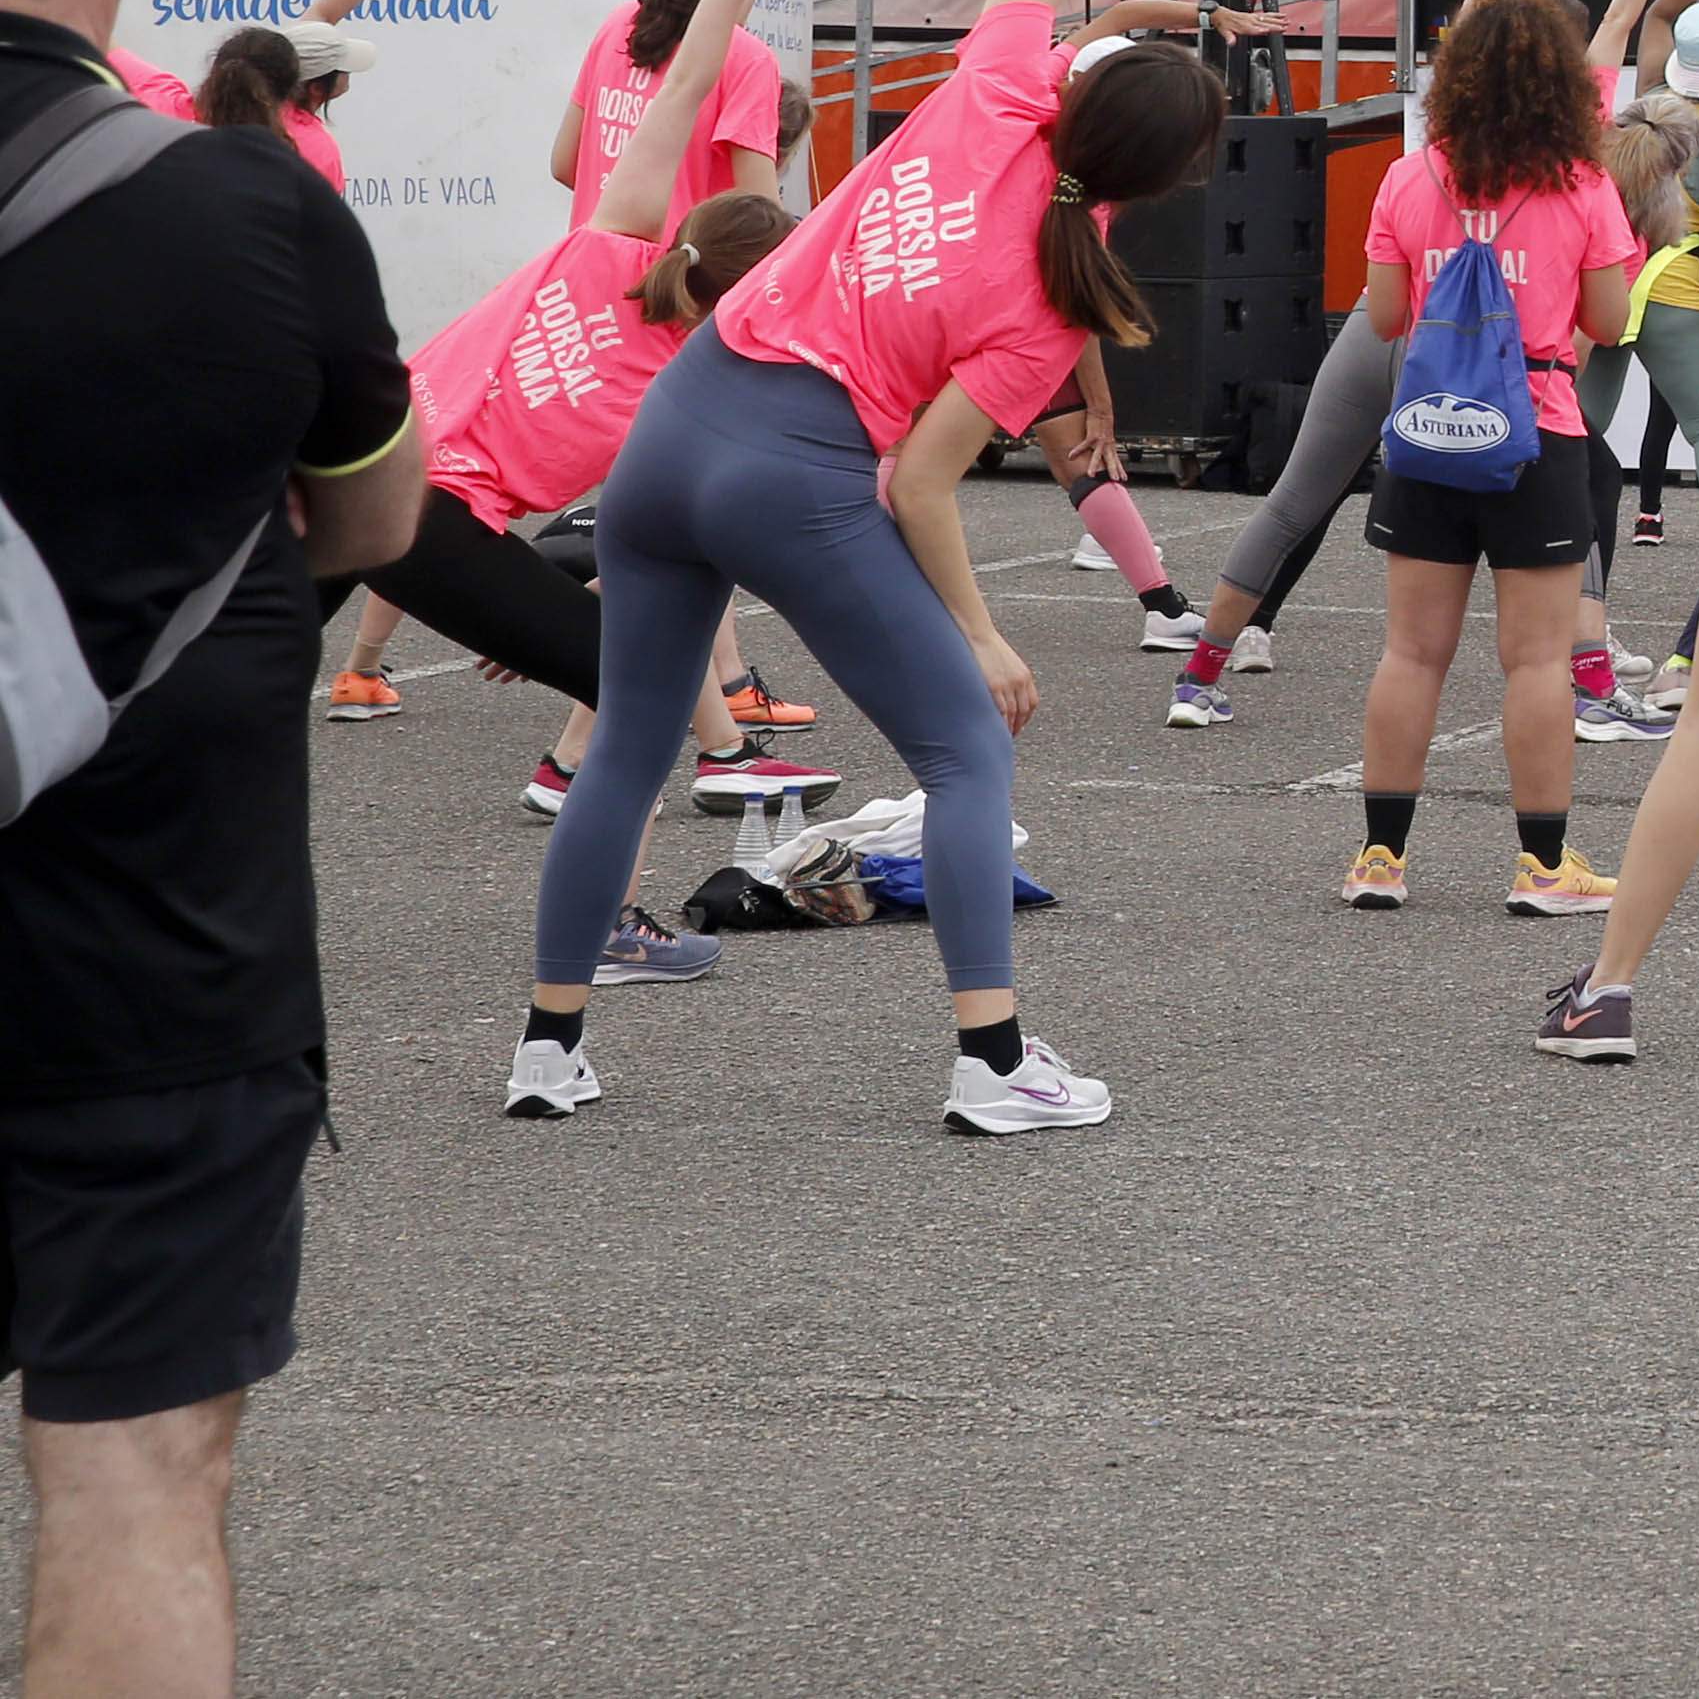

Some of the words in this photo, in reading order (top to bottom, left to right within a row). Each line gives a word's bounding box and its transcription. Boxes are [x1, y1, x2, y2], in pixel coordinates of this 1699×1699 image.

[403, 177, 430, 205] DE
[440, 176, 497, 207] VACA
[938, 189, 977, 244] TU
[859, 187, 898, 299] SUMA
[890, 155, 941, 302] DORSAL
[1461, 209, 1500, 244] TU
[534, 277, 604, 410] DORSAL
[584, 303, 624, 352] TU
[410, 371, 440, 425] OYSHO
[1403, 409, 1500, 440] ASTURIANA
[1606, 699, 1634, 718] FILA
